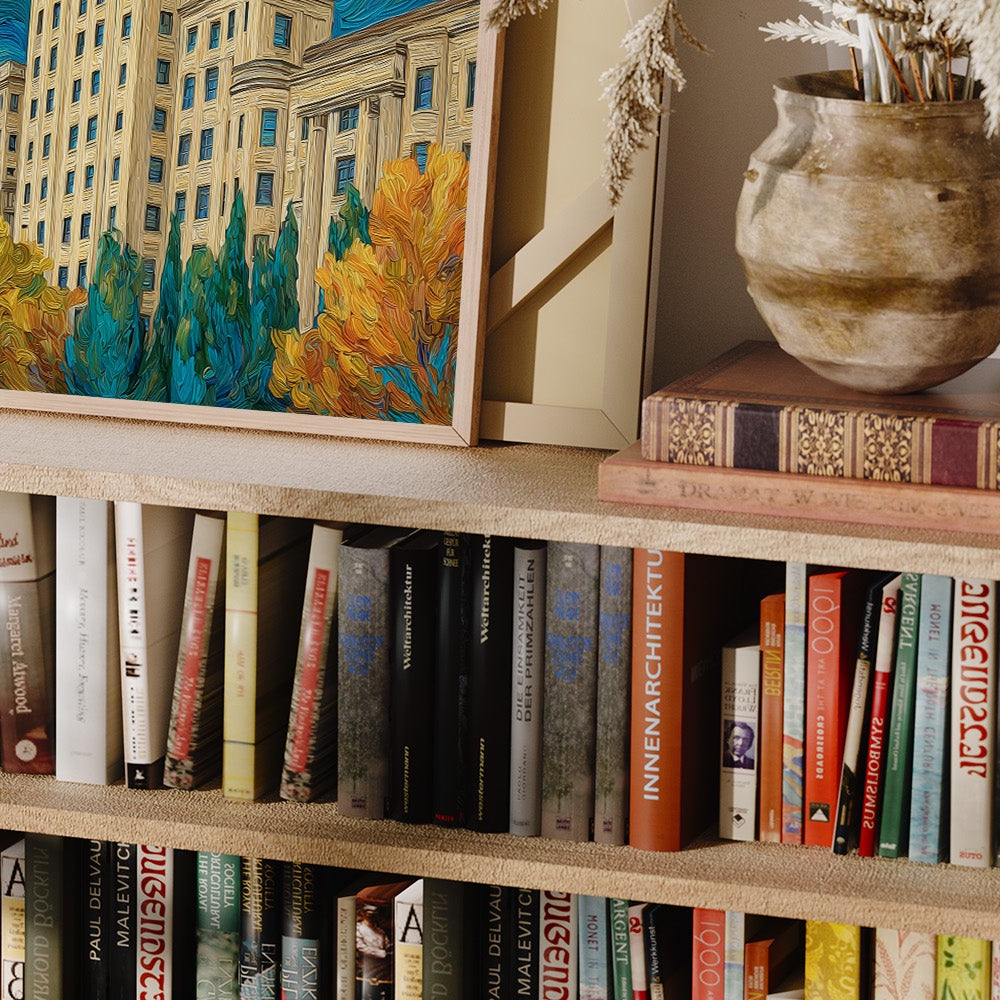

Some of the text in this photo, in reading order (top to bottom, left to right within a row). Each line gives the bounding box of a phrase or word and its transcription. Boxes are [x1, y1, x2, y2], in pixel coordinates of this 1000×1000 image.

[8, 595, 31, 715] Margaret Atwood
[403, 564, 412, 670] Weltarchitektur
[516, 574, 526, 686] EINSAMKEIT
[524, 558, 535, 722] DER PRIMZAHLEN
[644, 549, 662, 801] INNENARCHITEKTU
[89, 840, 101, 960] PAUL DELVAU
[489, 884, 500, 956] DELVAU
[588, 915, 598, 978] MONET IN
[613, 899, 629, 965] ARGENT
[650, 926, 659, 974] Werkkunst
[696, 921, 721, 987] 1900
